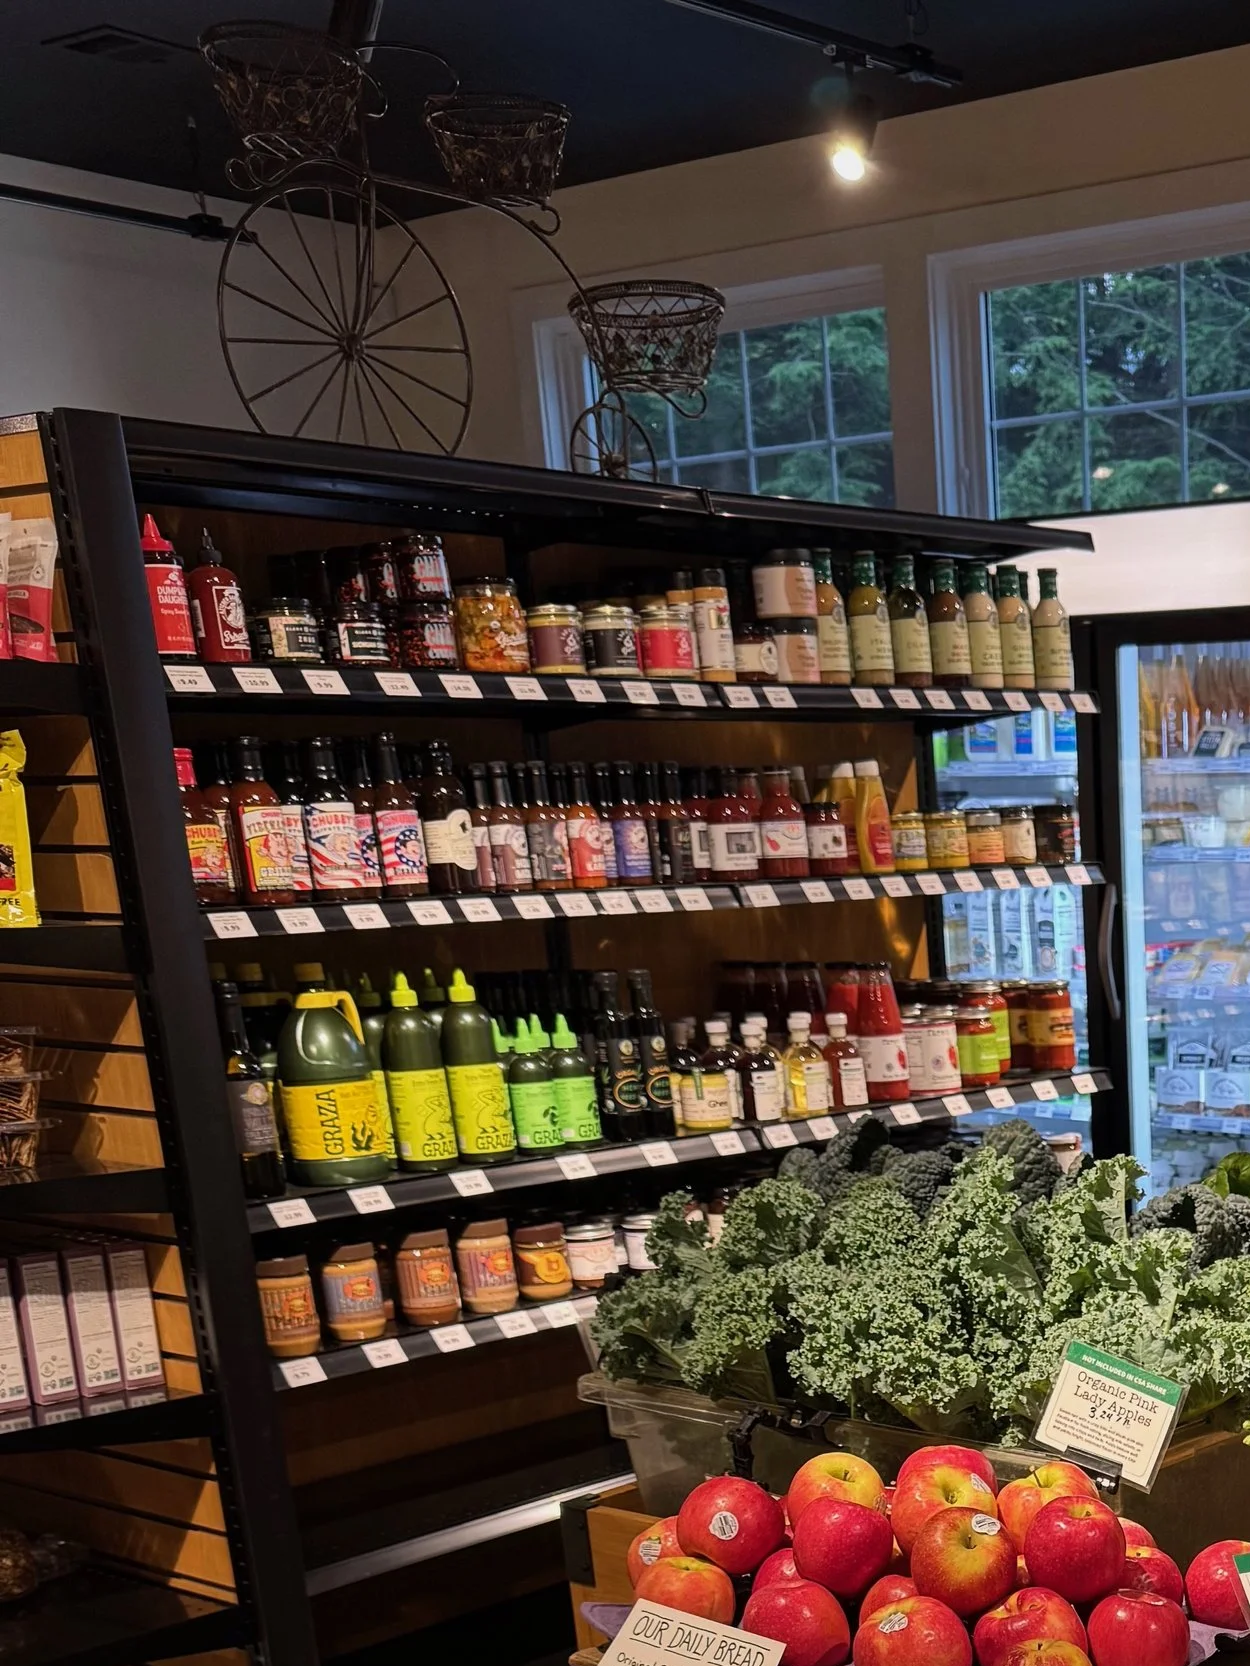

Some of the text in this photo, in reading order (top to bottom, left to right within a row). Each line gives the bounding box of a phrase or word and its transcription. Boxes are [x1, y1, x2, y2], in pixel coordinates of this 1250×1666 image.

[315, 1088, 346, 1156] GRAZA
[1078, 1371, 1159, 1414] Organic Pink
[1081, 1354, 1167, 1396] NOT INCLUDED IN CSA SHARE
[1074, 1385, 1152, 1428] Lady Apples
[632, 1615, 670, 1645] OUR
[667, 1626, 716, 1657] DAILY
